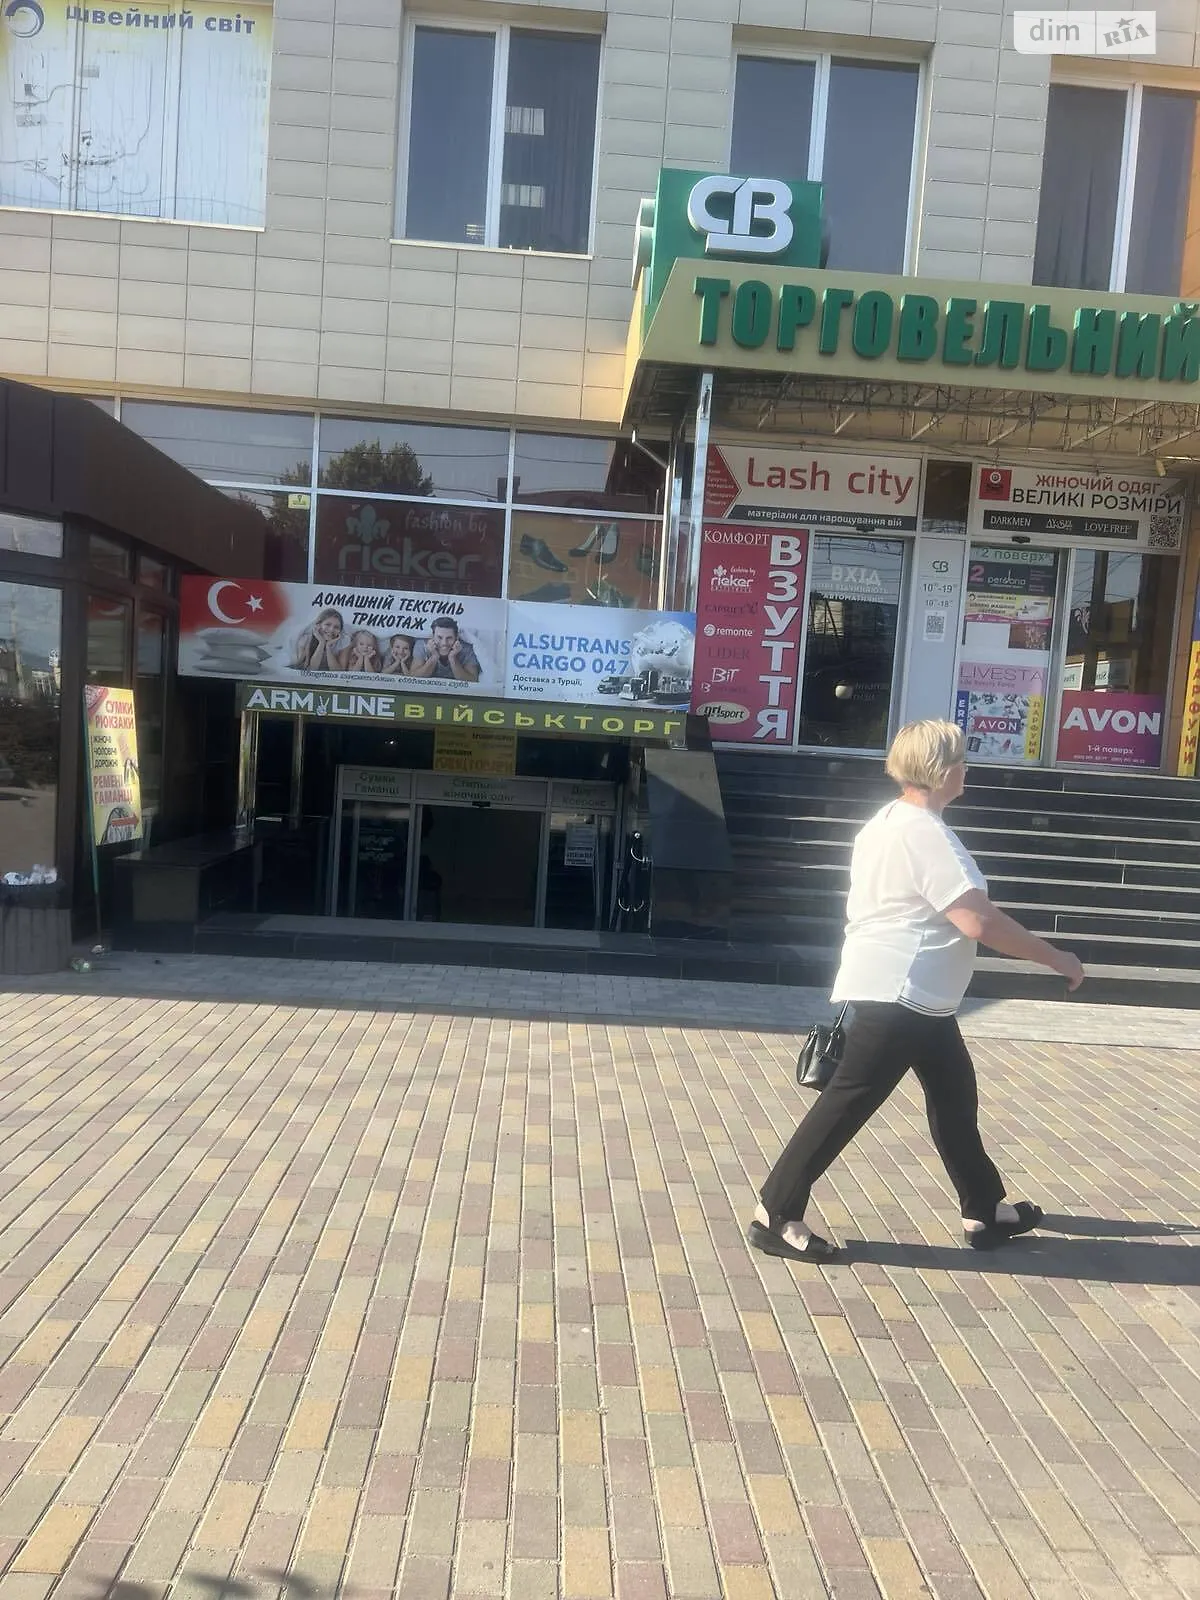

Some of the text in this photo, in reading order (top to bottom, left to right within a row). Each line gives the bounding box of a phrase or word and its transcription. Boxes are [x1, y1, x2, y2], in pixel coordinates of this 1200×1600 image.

[66, 6, 256, 34] швейний світ
[694, 276, 1200, 383] ТОРГОВЕЛЬНИЙ
[747, 457, 831, 492] Lash
[847, 465, 914, 505] city
[1036, 474, 1161, 495] ЖІНОЧИЙ ОДЯГ
[1012, 488, 1084, 508] ВЕЛИКІ
[1091, 495, 1181, 514] РОЗМІРИ
[747, 509, 902, 528] матеріали для нарощування вій
[990, 515, 1031, 527] DARKMEN
[704, 530, 769, 546] КОМФОРТ
[338, 537, 484, 579] rieker
[982, 548, 1045, 563] 2 поверх
[711, 575, 754, 588] rieker
[970, 564, 984, 582] 2
[312, 591, 464, 616] ДОМАШНІЙ ТЕКСТИЛЬ
[352, 612, 427, 631] ТРИКОТАЖ
[716, 626, 753, 637] remonte
[752, 535, 801, 739] ВЗУТТЯ
[513, 632, 631, 655] ALSUTRANS
[513, 652, 629, 675] CARGO 047
[960, 664, 1043, 681] LIVESTA
[513, 674, 550, 684] Доставка
[518, 685, 544, 693] Китаю
[105, 700, 134, 715] СУМКИ
[332, 694, 395, 717] LINE
[95, 715, 134, 729] РЮКЗАКИ
[404, 704, 681, 735] ВІЙСЬКТОРГ
[978, 719, 1017, 731] AVON
[1062, 707, 1161, 735] AVON
